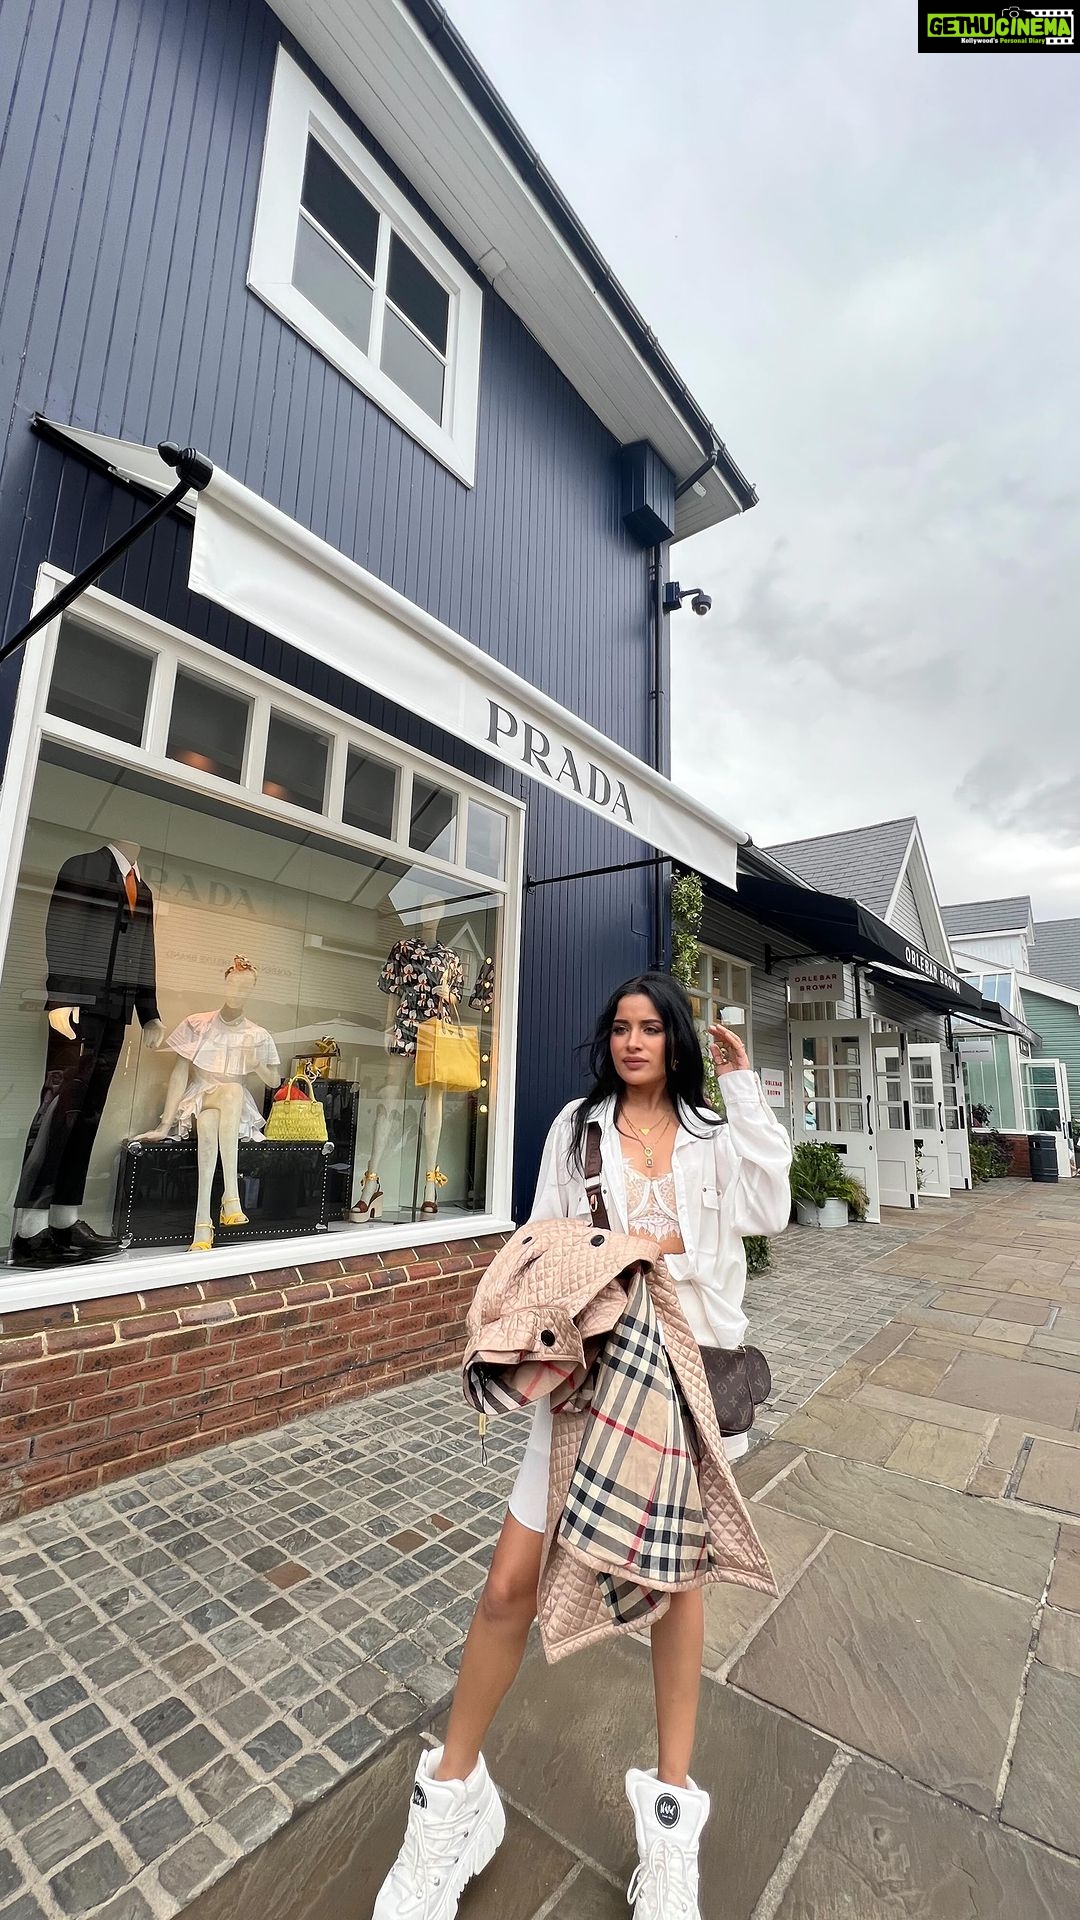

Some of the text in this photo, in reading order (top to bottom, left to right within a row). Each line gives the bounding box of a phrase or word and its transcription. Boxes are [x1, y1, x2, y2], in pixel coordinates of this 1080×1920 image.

[484, 697, 635, 826] PRADA
[904, 946, 939, 981] ORLEBAR
[794, 973, 837, 983] ORLEBAR
[799, 983, 833, 992] BROWN
